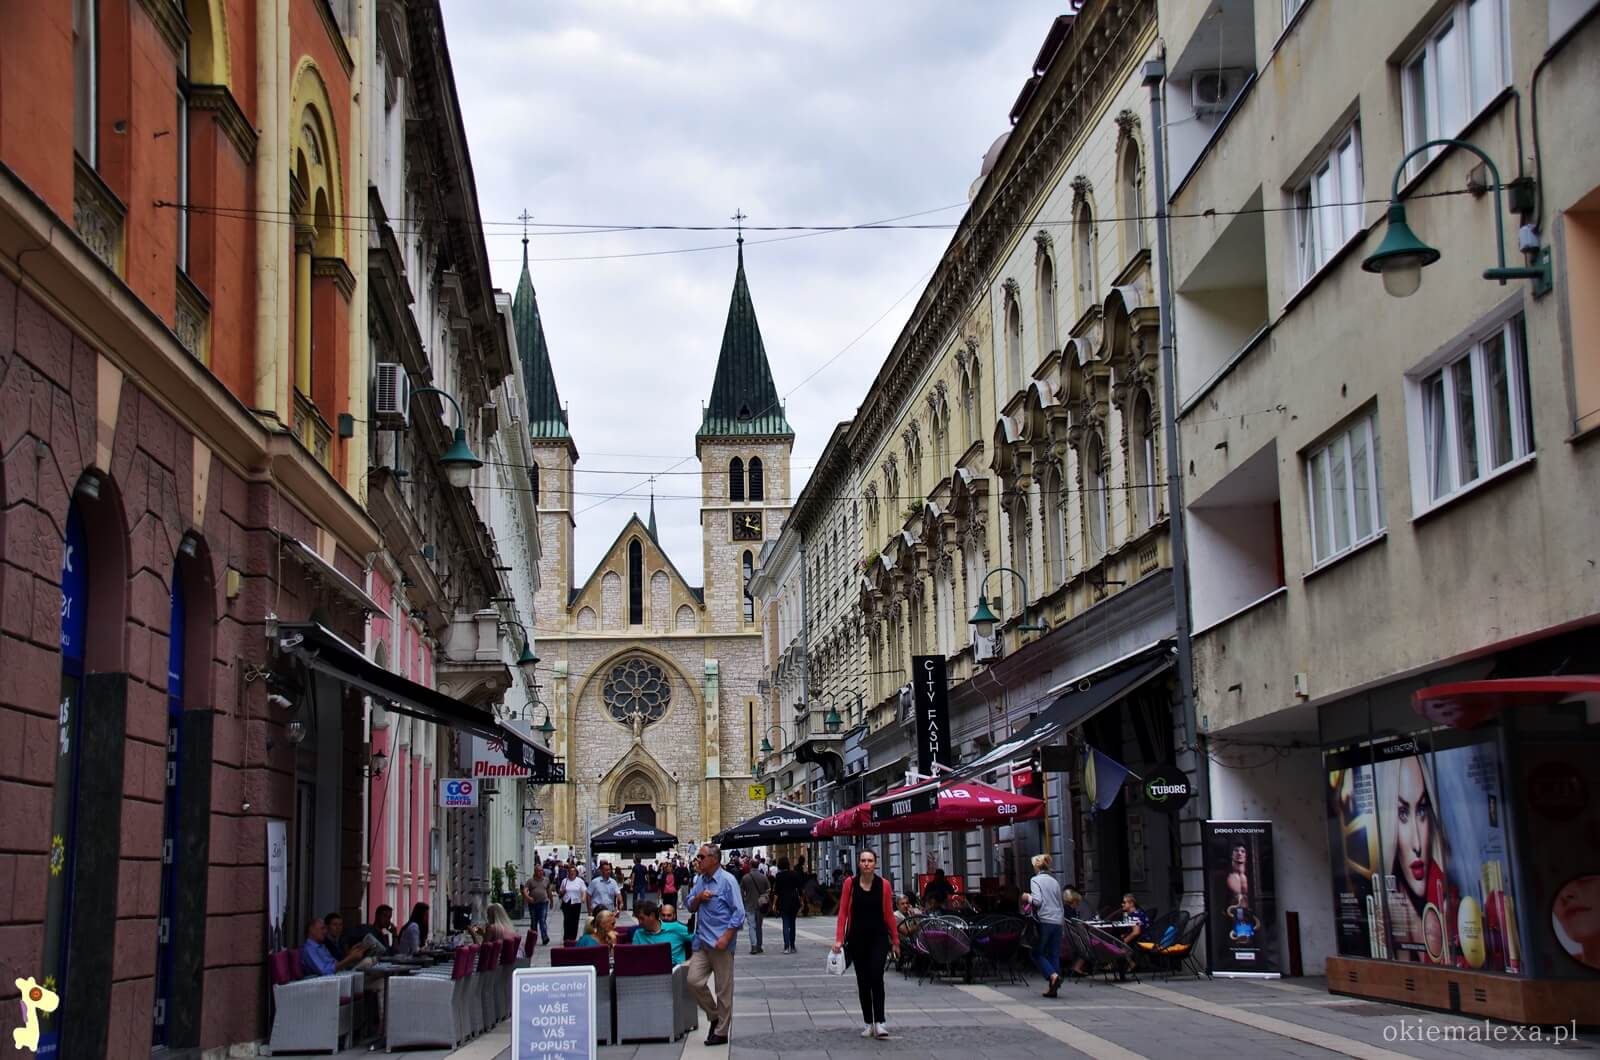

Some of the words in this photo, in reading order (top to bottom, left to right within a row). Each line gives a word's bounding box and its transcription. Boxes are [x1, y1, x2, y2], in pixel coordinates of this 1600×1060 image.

[924, 660, 936, 702] CITY
[927, 709, 939, 763] FASHI
[449, 783, 471, 794] TC
[1151, 784, 1187, 795] TUBORG
[997, 804, 1018, 815] ella
[521, 983, 549, 995] Optic
[551, 982, 587, 992] Center
[539, 1001, 569, 1014] VAŠE
[531, 1015, 577, 1026] GODINE
[542, 1026, 565, 1038] VAŠ
[530, 1040, 578, 1052] POPUST
